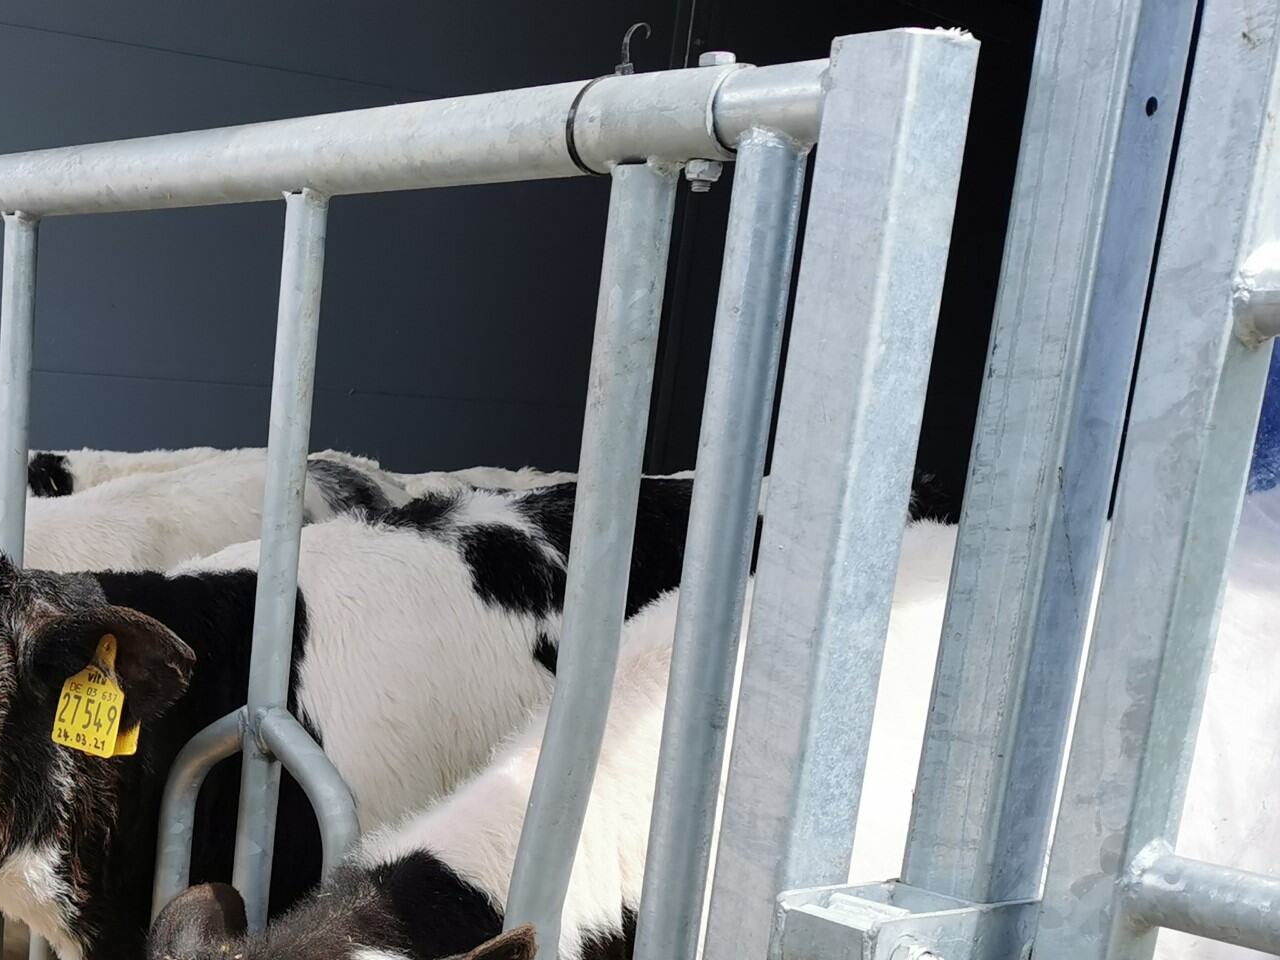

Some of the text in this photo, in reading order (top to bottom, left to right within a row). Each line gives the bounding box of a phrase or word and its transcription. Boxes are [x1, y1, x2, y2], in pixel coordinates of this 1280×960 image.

[69, 682, 82, 693] DE
[86, 687, 98, 697] 03
[58, 692, 118, 736] 27549
